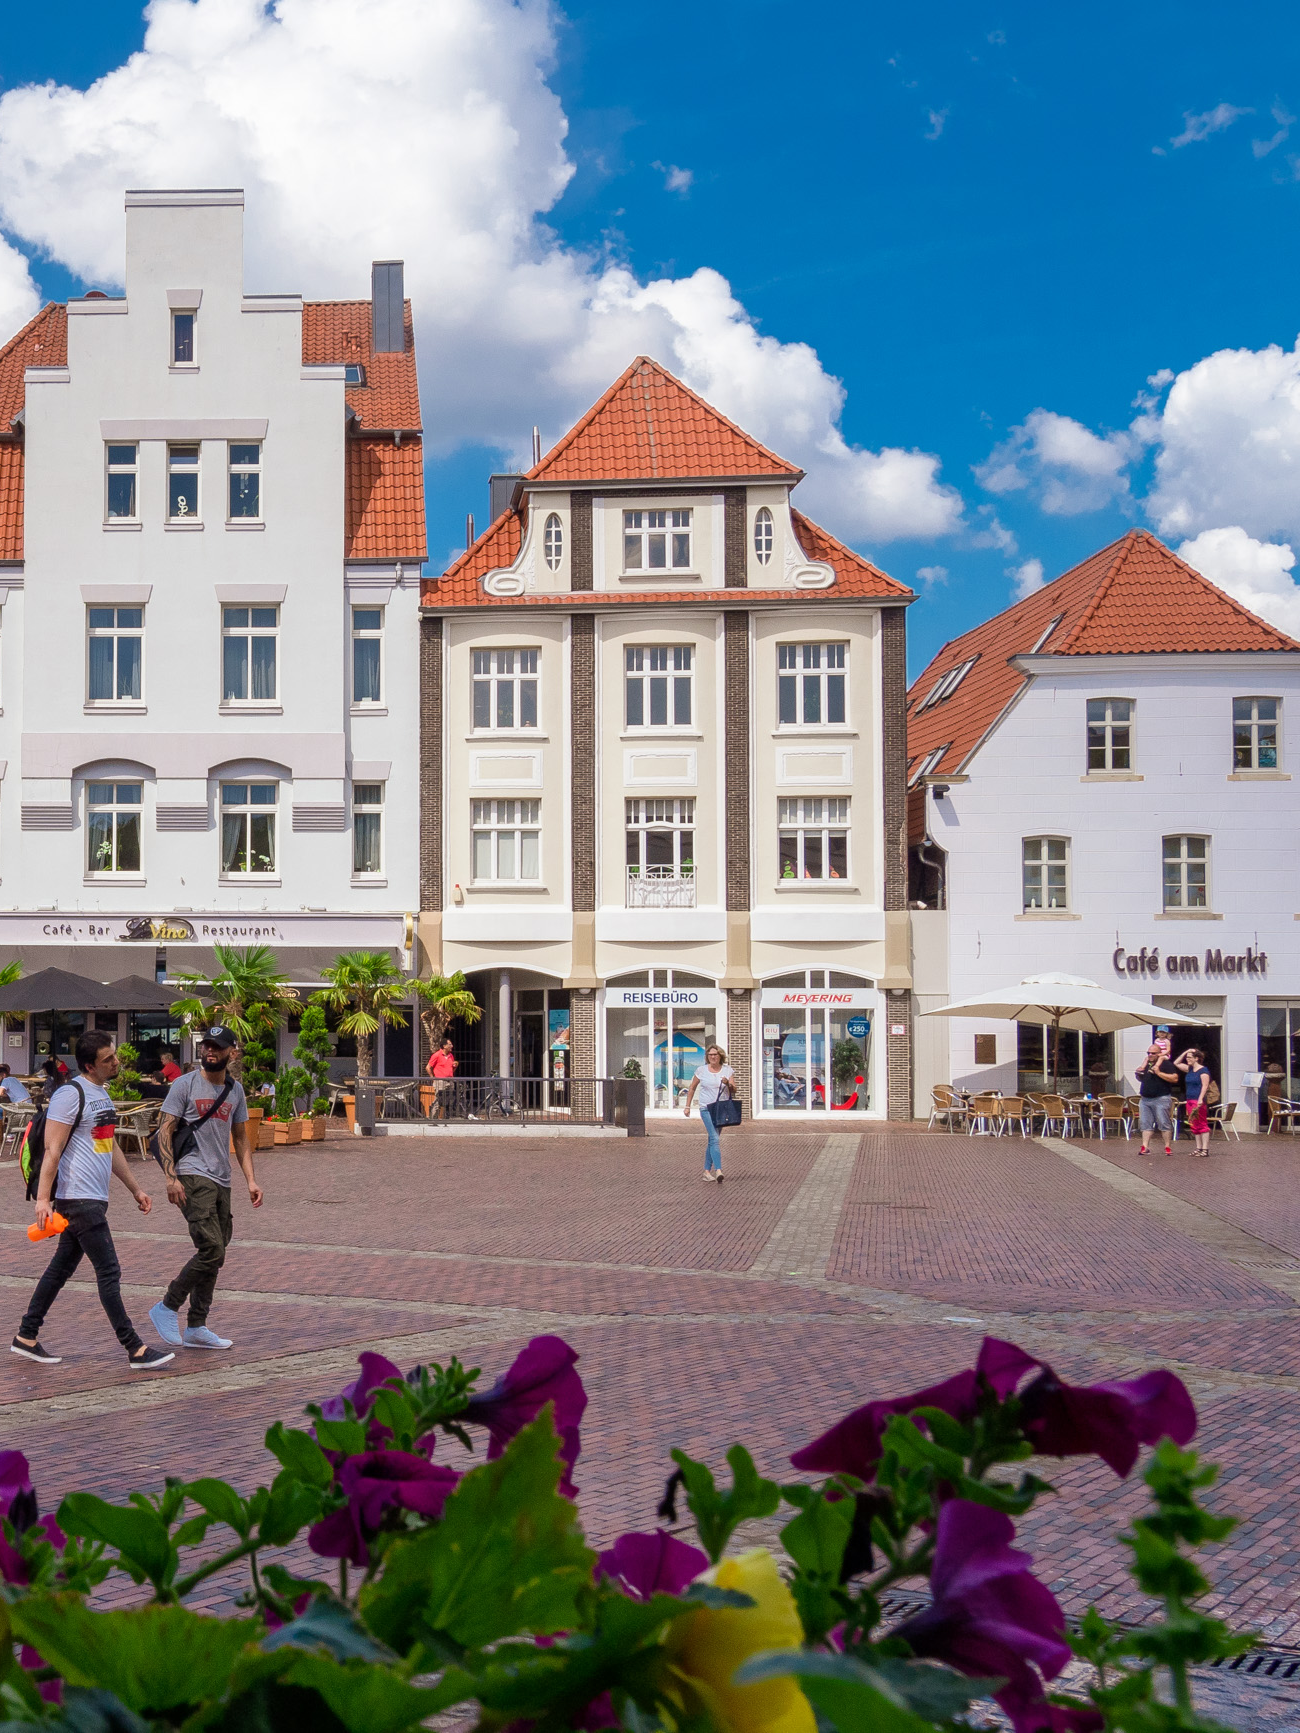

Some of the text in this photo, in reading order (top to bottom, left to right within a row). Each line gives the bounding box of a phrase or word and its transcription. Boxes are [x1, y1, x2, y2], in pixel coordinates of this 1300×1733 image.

[43, 924, 73, 936] Café
[89, 924, 110, 936] Bar
[149, 922, 188, 939] Vino
[203, 924, 277, 936] Restaurant
[1113, 946, 1268, 973] Café am Markt
[623, 990, 698, 1003] REISEBÜRO
[783, 994, 854, 1004] MEYERING
